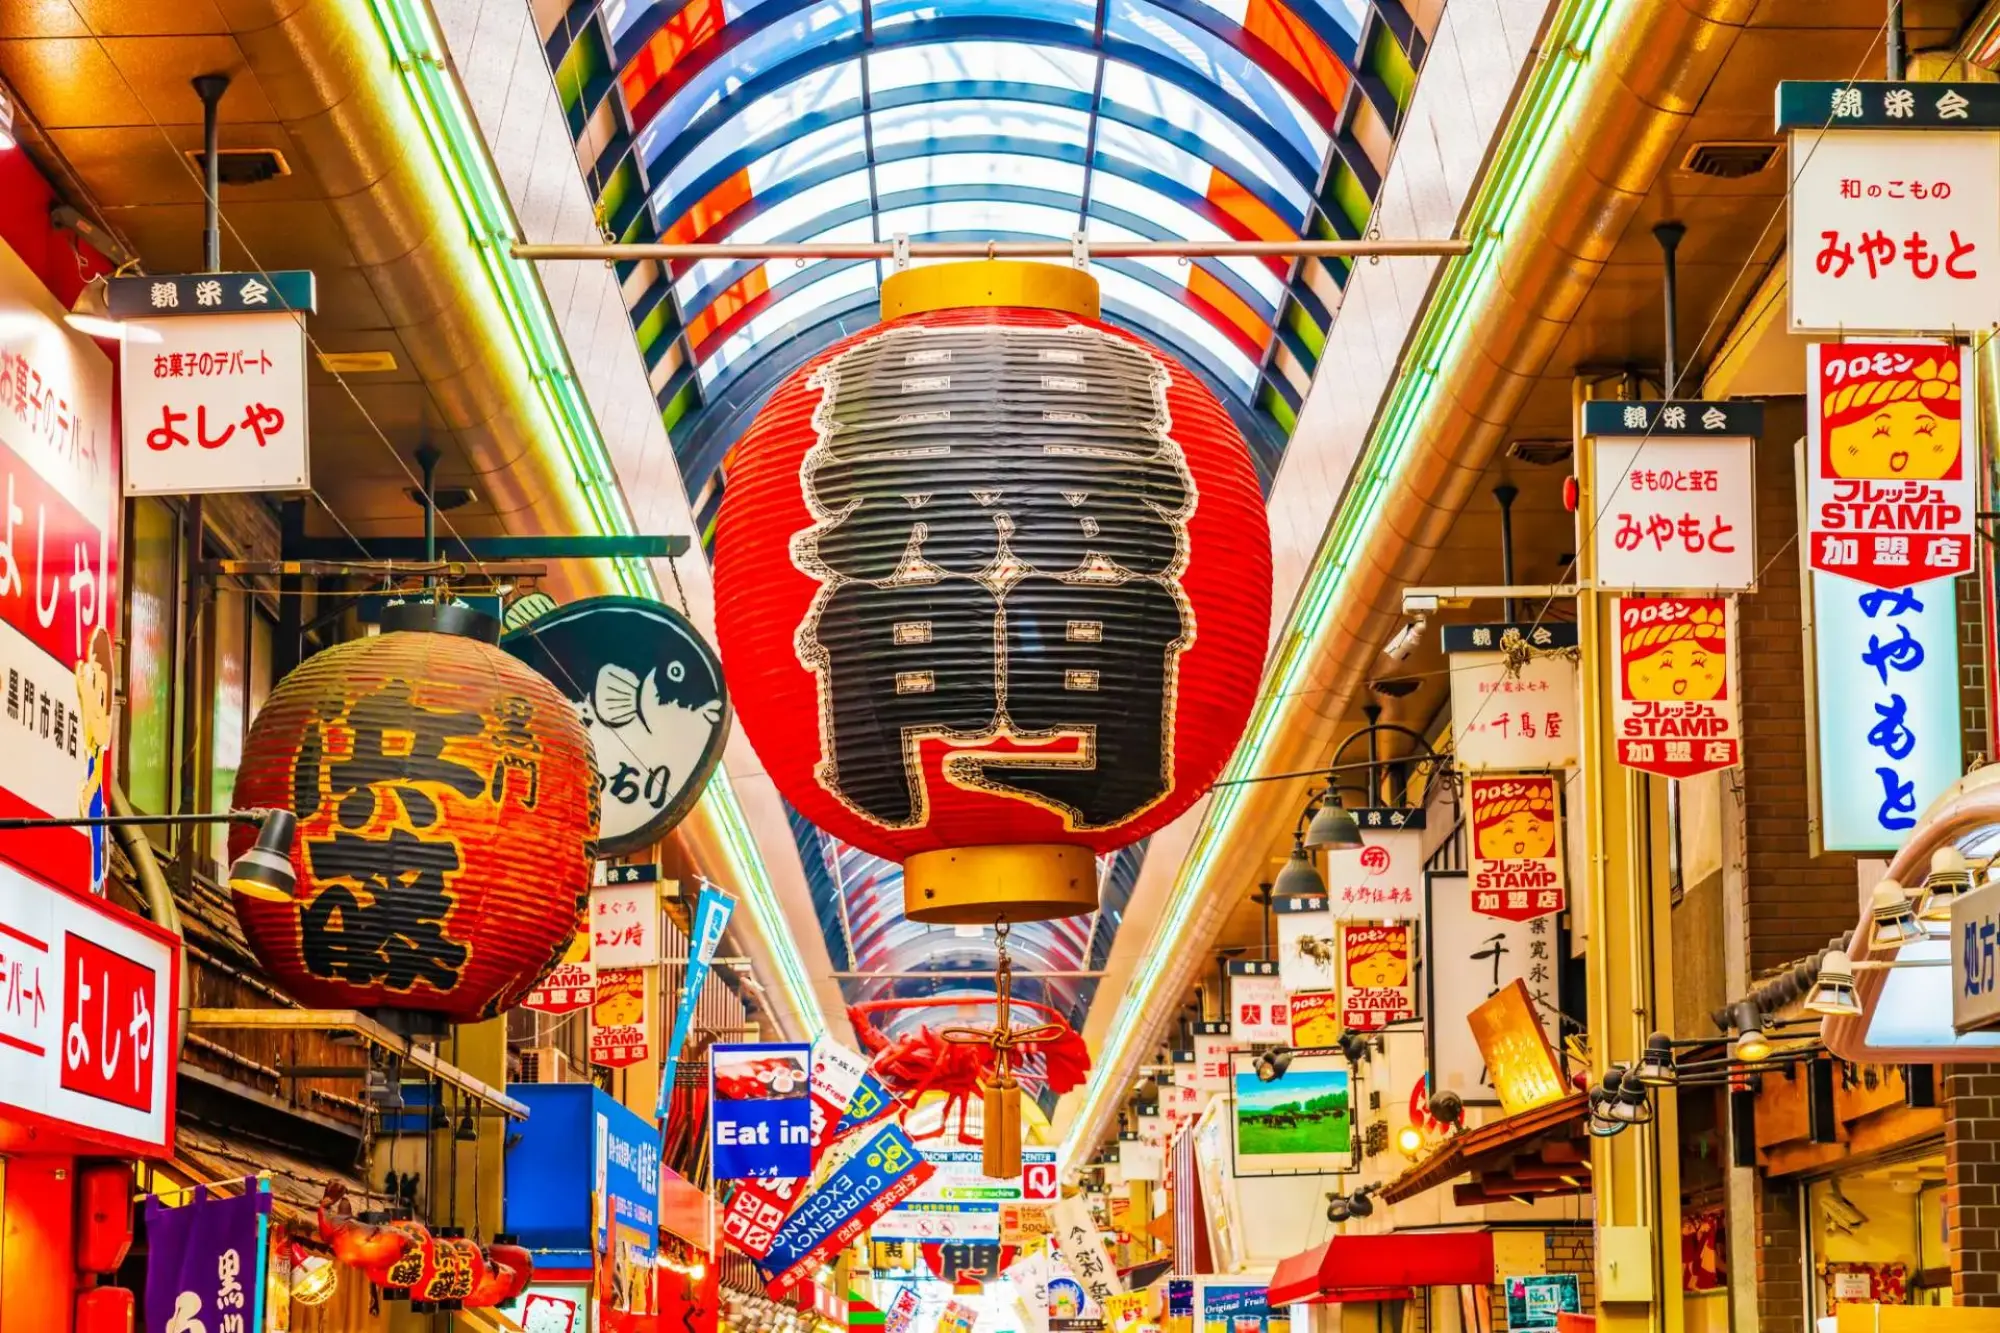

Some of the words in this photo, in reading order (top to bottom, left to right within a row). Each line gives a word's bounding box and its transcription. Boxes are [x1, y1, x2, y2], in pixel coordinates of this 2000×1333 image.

[1831, 88, 1970, 119] 親栄会
[1840, 179, 1951, 199] 和のこもの
[1816, 230, 1977, 279] みやもと
[151, 279, 269, 307] 親栄会
[153, 349, 273, 378] お菓子のデパート
[1825, 351, 1915, 385] クロモン
[146, 403, 284, 451] よしや
[1623, 406, 1727, 430] 親栄会
[1630, 470, 1718, 491] きものと宝石
[1833, 480, 1945, 503] フレッシュ
[1821, 503, 1961, 530] STAMP
[1615, 512, 1735, 553] みやもと
[1821, 535, 1962, 567] 加盟店
[0, 472, 96, 658] よしや
[1624, 602, 1690, 628] クロモン
[7, 668, 78, 759] 黒門市場店
[1632, 702, 1715, 717] フレッシュ
[1491, 711, 1563, 739] 千鳥屋
[1624, 718, 1729, 737] STAMP
[1626, 741, 1730, 763] 加盟店
[1474, 783, 1526, 804] クロモン
[1483, 860, 1547, 872] フレッシュ
[1476, 873, 1557, 889] STAMP
[1478, 891, 1557, 910] 加盟店
[1348, 929, 1386, 945] クロモン
[1963, 912, 2000, 999] 処方
[550, 963, 582, 974] ッシュ
[538, 974, 591, 989] TAMP
[1352, 987, 1400, 997] フレッシュ
[526, 989, 591, 1004] 加盟店
[1292, 996, 1324, 1011] クロモン
[1347, 997, 1408, 1009] STAMP
[66, 956, 152, 1093] よしや
[597, 1025, 637, 1035] フレッシュ
[593, 1033, 644, 1046] STAMP
[595, 1046, 645, 1060] 加盟店
[716, 1121, 770, 1146] Eat
[780, 1120, 809, 1145] in
[790, 1175, 882, 1259] CURRENCY
[1205, 1301, 1241, 1314] Original
